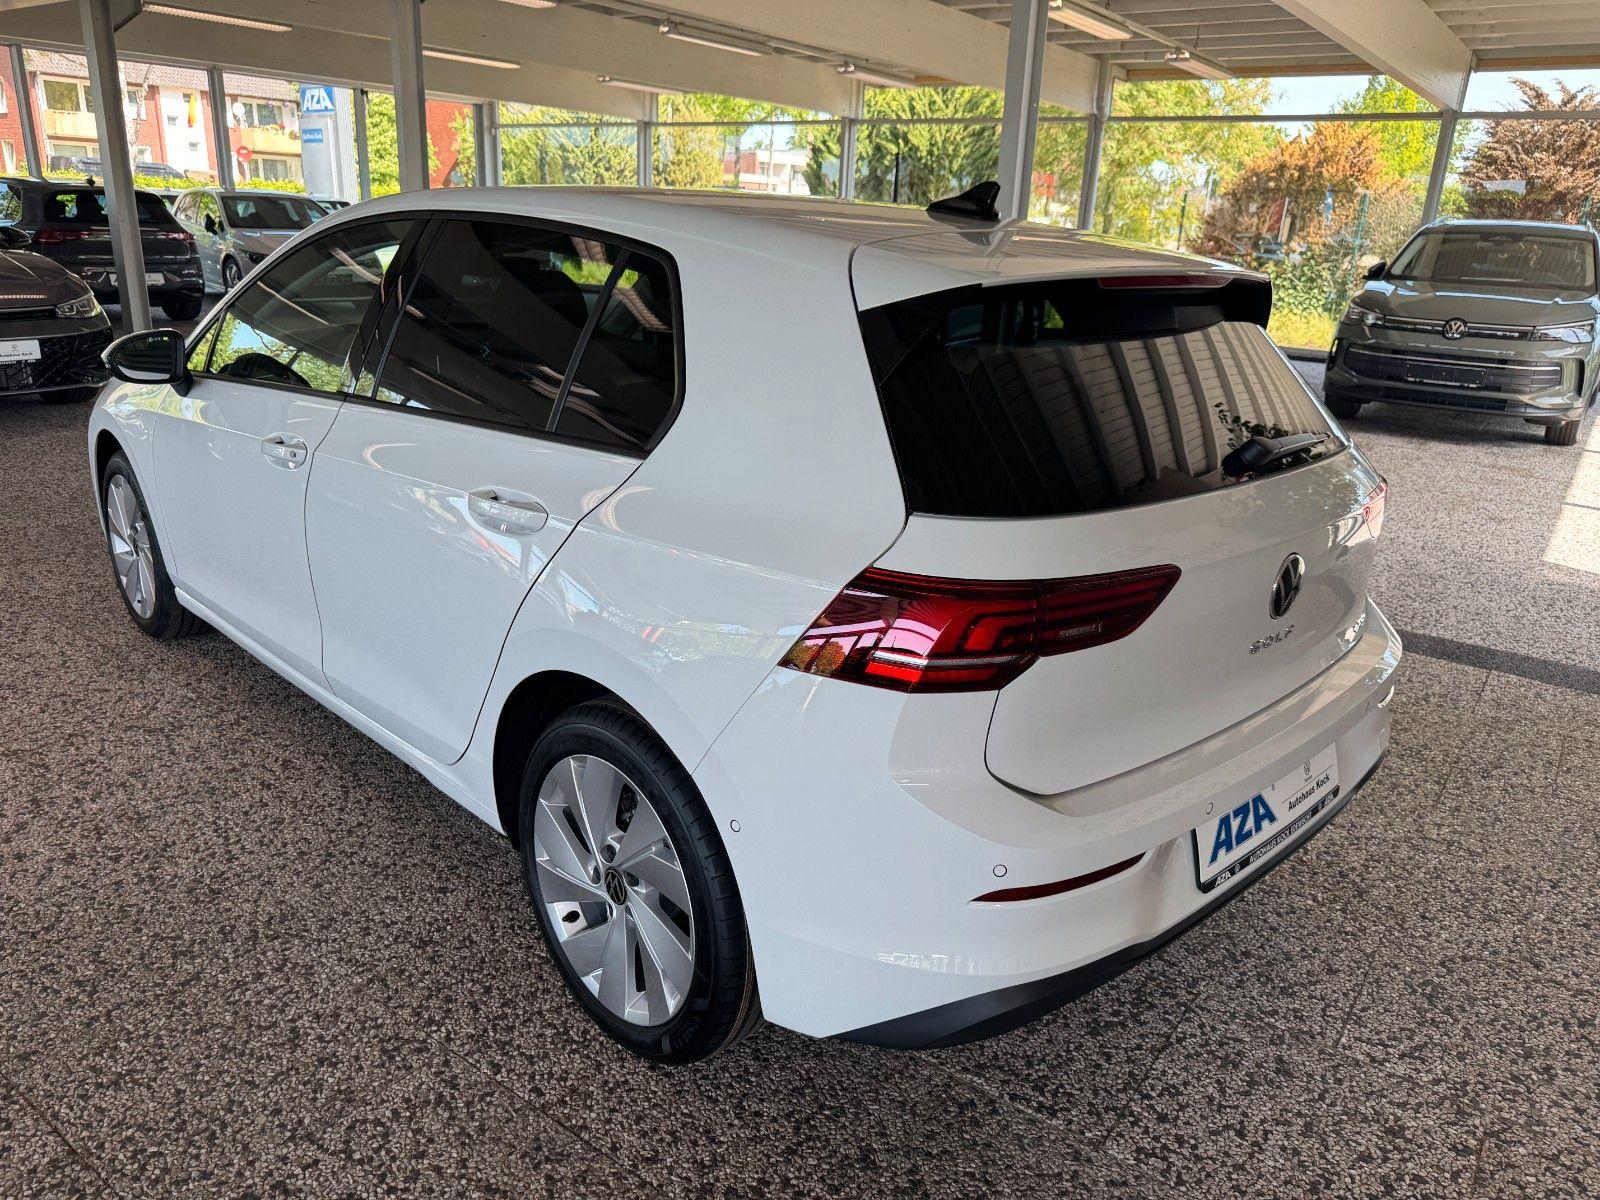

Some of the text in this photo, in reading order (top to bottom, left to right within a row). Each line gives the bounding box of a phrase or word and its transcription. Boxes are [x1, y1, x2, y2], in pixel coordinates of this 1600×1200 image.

[303, 88, 334, 111] AZA
[1249, 624, 1295, 655] GOLF
[1288, 773, 1330, 812] Autohaus Kock
[1207, 791, 1279, 867] AZA
[1214, 870, 1232, 887] AZA
